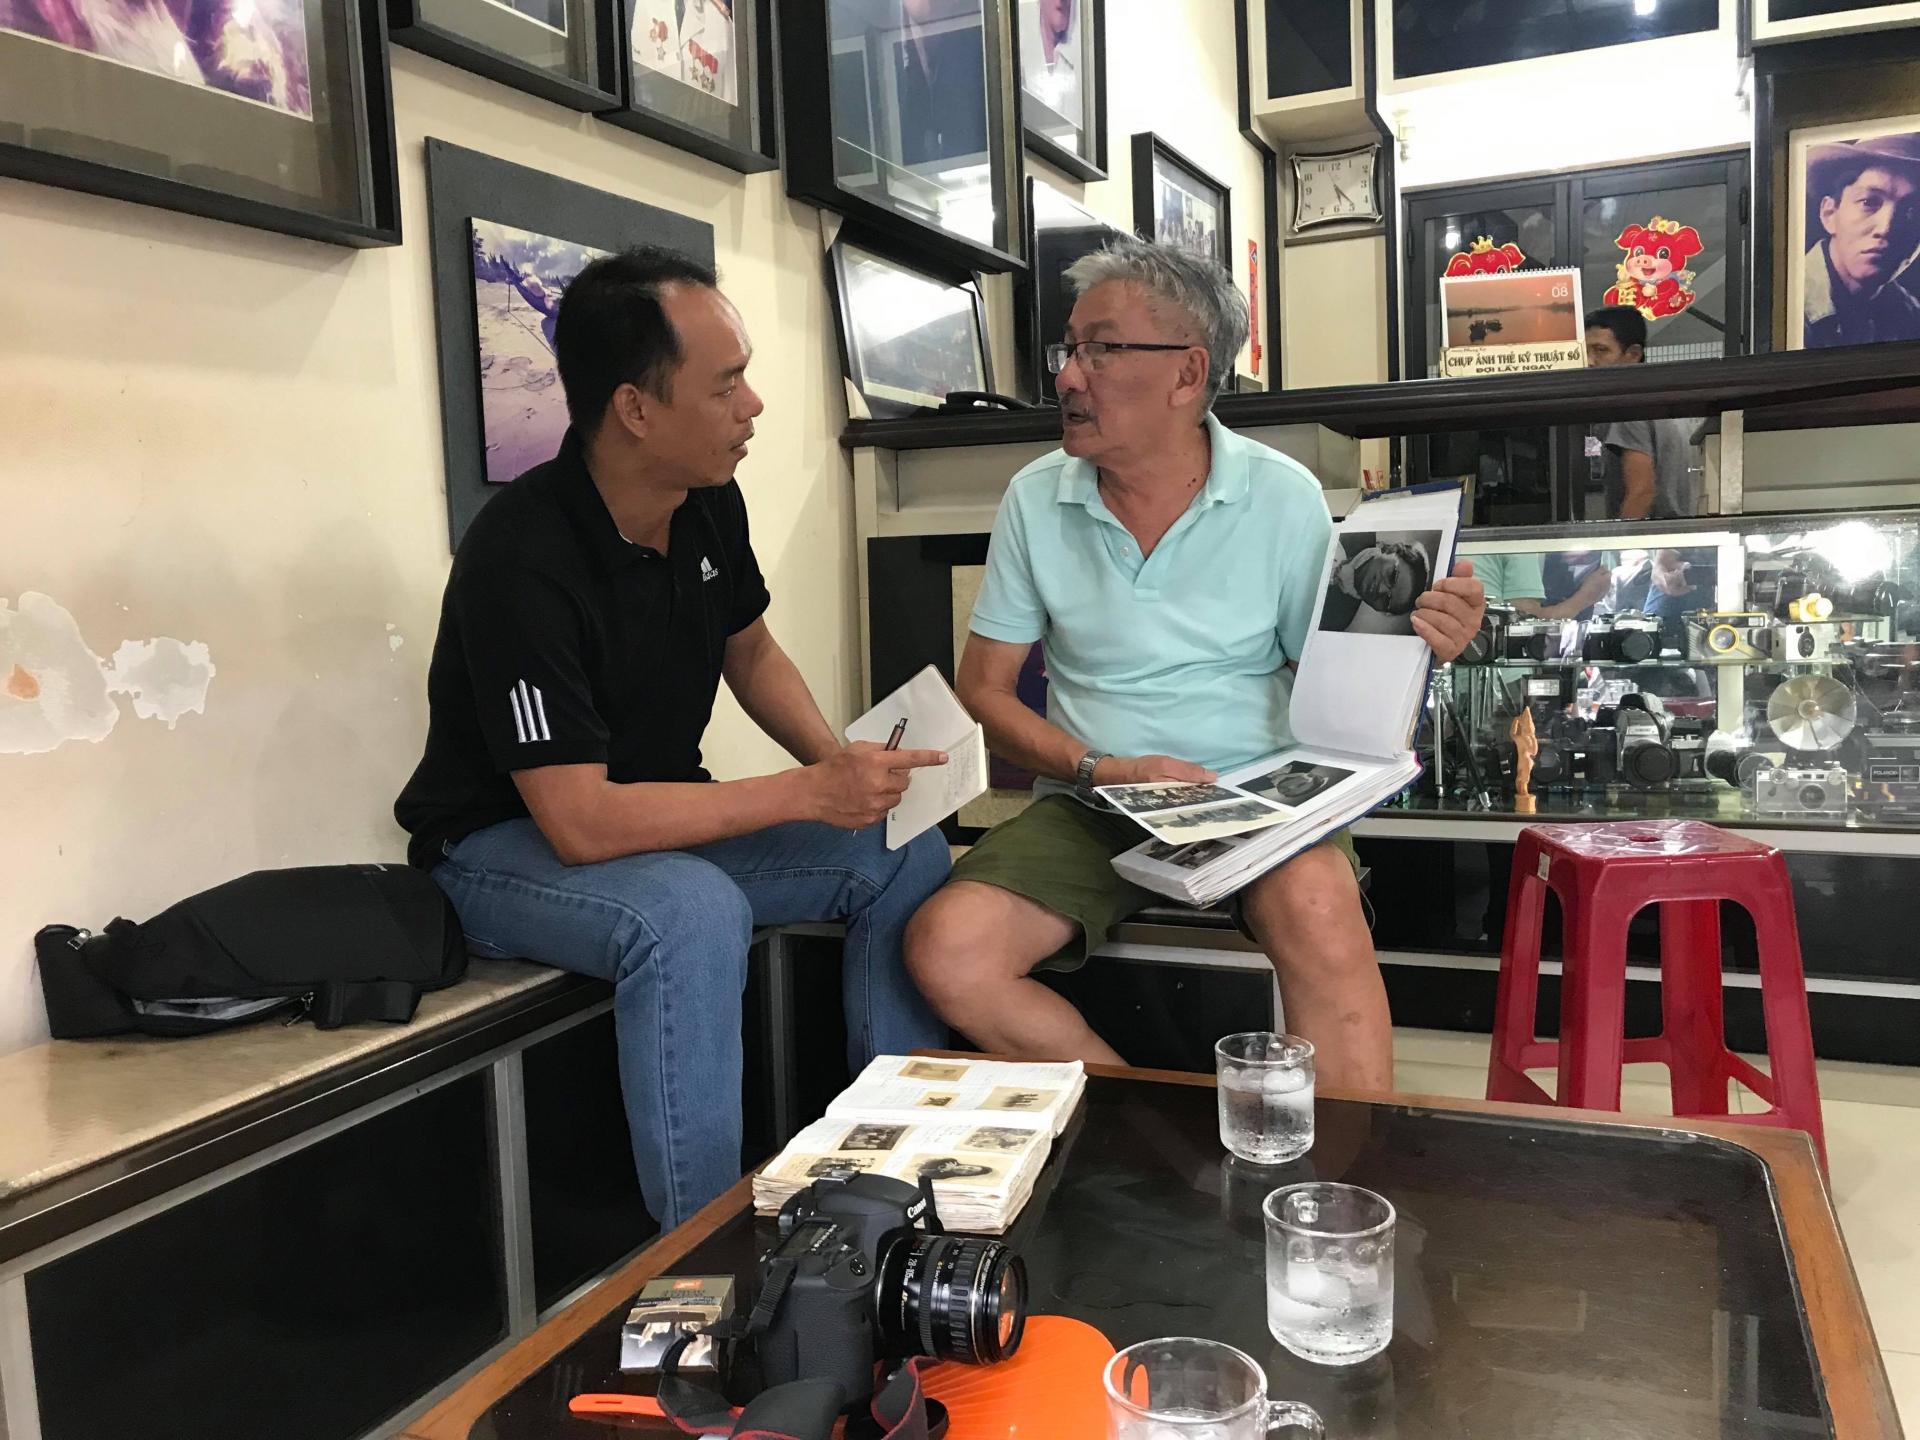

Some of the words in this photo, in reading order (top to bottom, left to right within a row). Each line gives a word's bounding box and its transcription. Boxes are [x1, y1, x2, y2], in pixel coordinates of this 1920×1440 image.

[1318, 164, 1325, 172] 11
[1331, 162, 1341, 171] 12
[1304, 173, 1313, 182] 10
[1551, 286, 1568, 297] 08
[1448, 356, 1474, 368] CHỤP
[1475, 352, 1495, 365] ẢNH
[1534, 350, 1565, 364] THUẬT
[1567, 347, 1581, 361] SỐ
